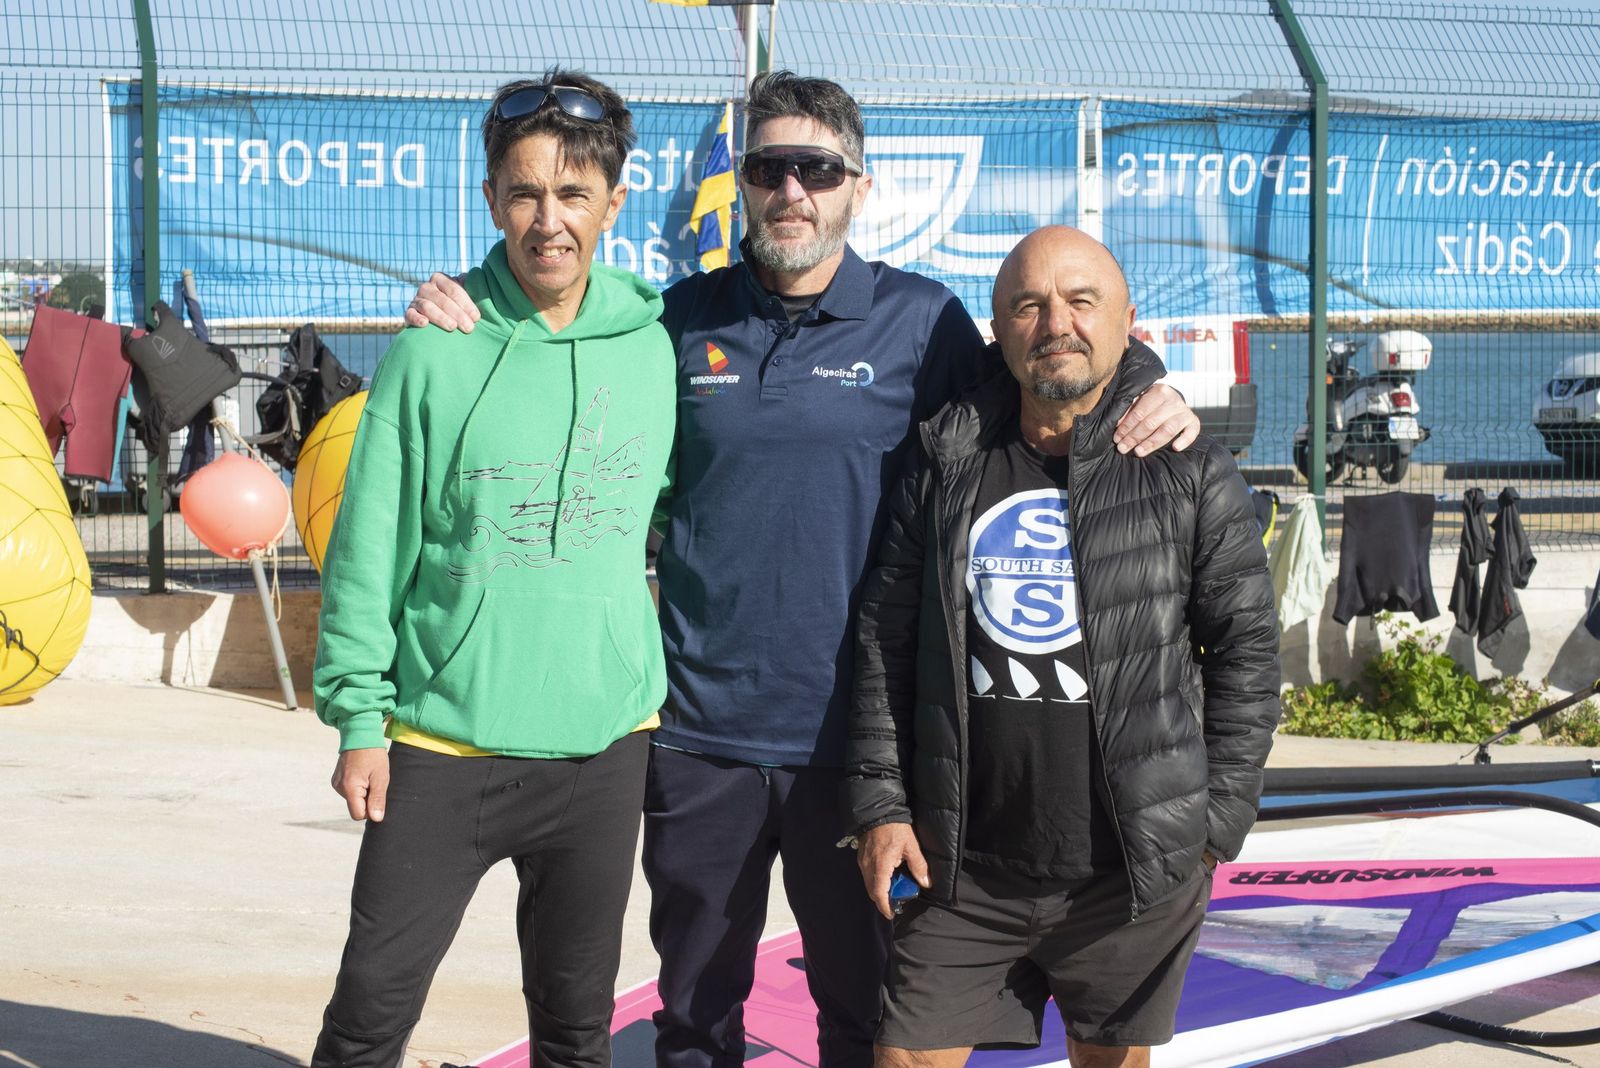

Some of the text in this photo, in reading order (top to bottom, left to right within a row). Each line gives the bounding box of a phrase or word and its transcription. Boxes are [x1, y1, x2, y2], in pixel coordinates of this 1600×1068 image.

[1163, 324, 1218, 344] LÍNEA
[690, 374, 740, 385] WINDSURFER
[812, 366, 857, 379] Algeciras
[841, 379, 857, 387] Port
[971, 557, 1044, 573] SOUTH
[1011, 582, 1065, 628] S
[1228, 866, 1498, 885] WINDSURFER
